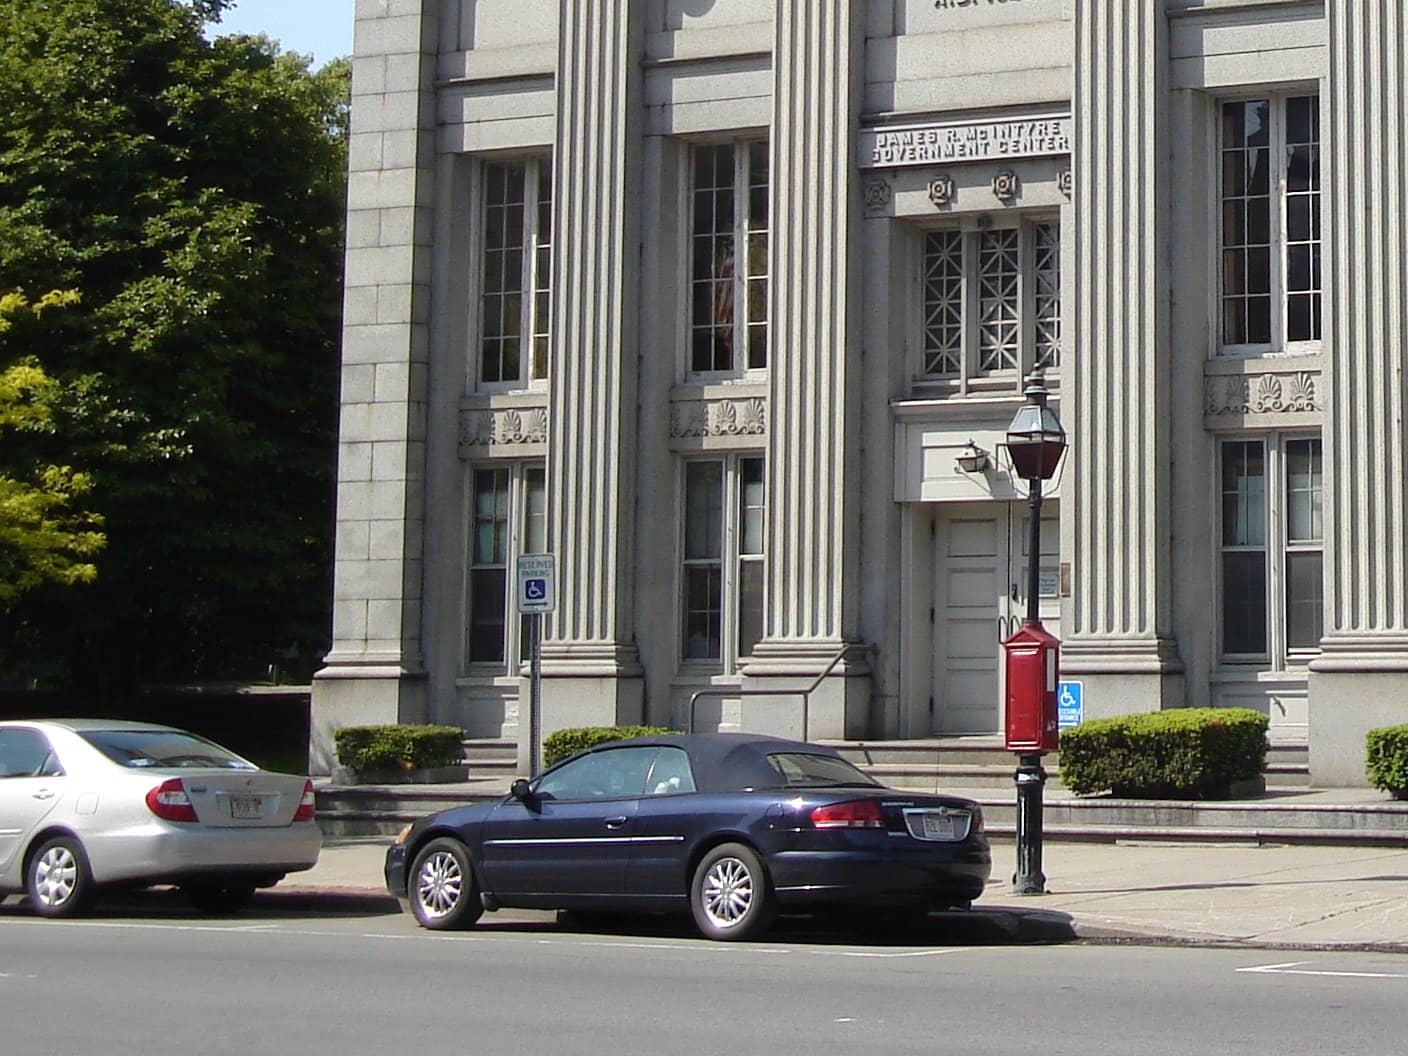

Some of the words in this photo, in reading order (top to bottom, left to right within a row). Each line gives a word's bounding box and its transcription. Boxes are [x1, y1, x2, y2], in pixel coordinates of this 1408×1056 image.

[872, 141, 991, 164] GOVERNMENT
[999, 135, 1071, 155] CENTER
[876, 129, 939, 149] JAMES
[946, 128, 963, 143] R.
